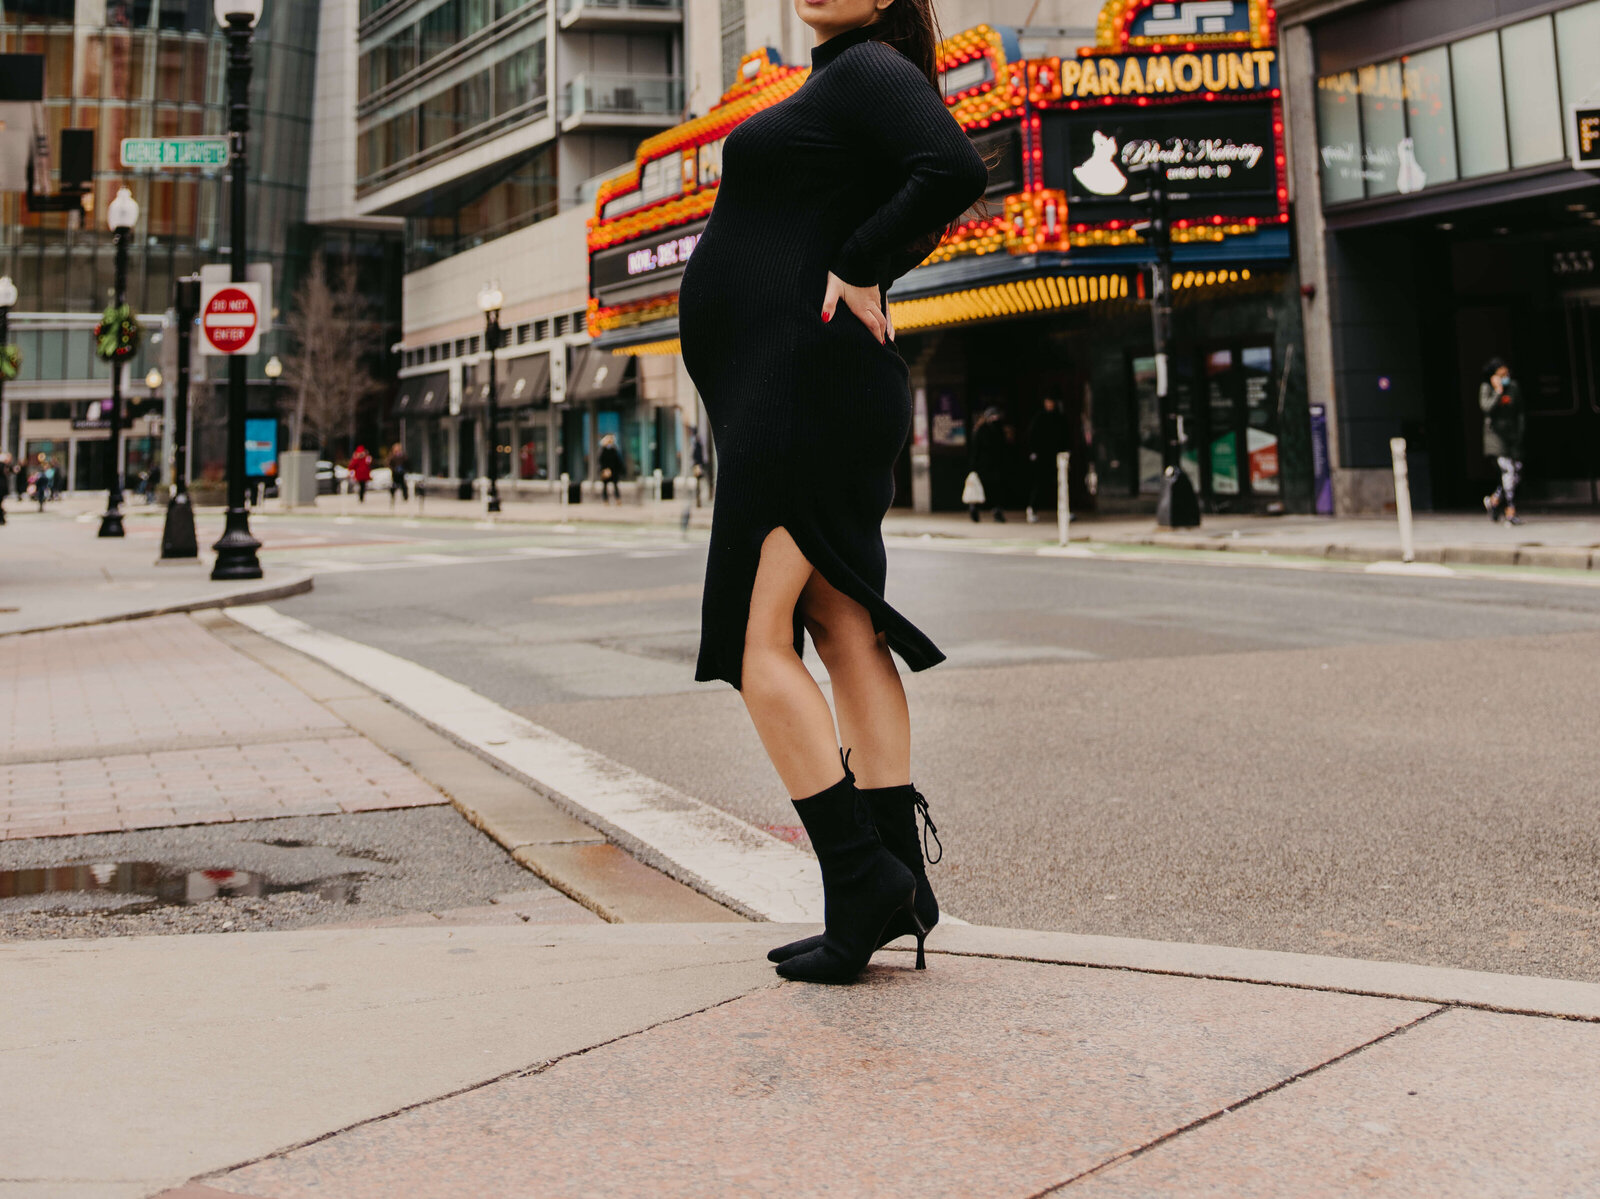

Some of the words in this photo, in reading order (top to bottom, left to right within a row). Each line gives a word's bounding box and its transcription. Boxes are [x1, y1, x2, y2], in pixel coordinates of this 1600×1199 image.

[1062, 51, 1275, 97] PARAMOUNT
[127, 142, 161, 162] AVENUE
[178, 142, 226, 162] LAFAYETTE
[211, 299, 228, 312] DO
[229, 298, 249, 312] NOT
[213, 328, 246, 341] ENTER
